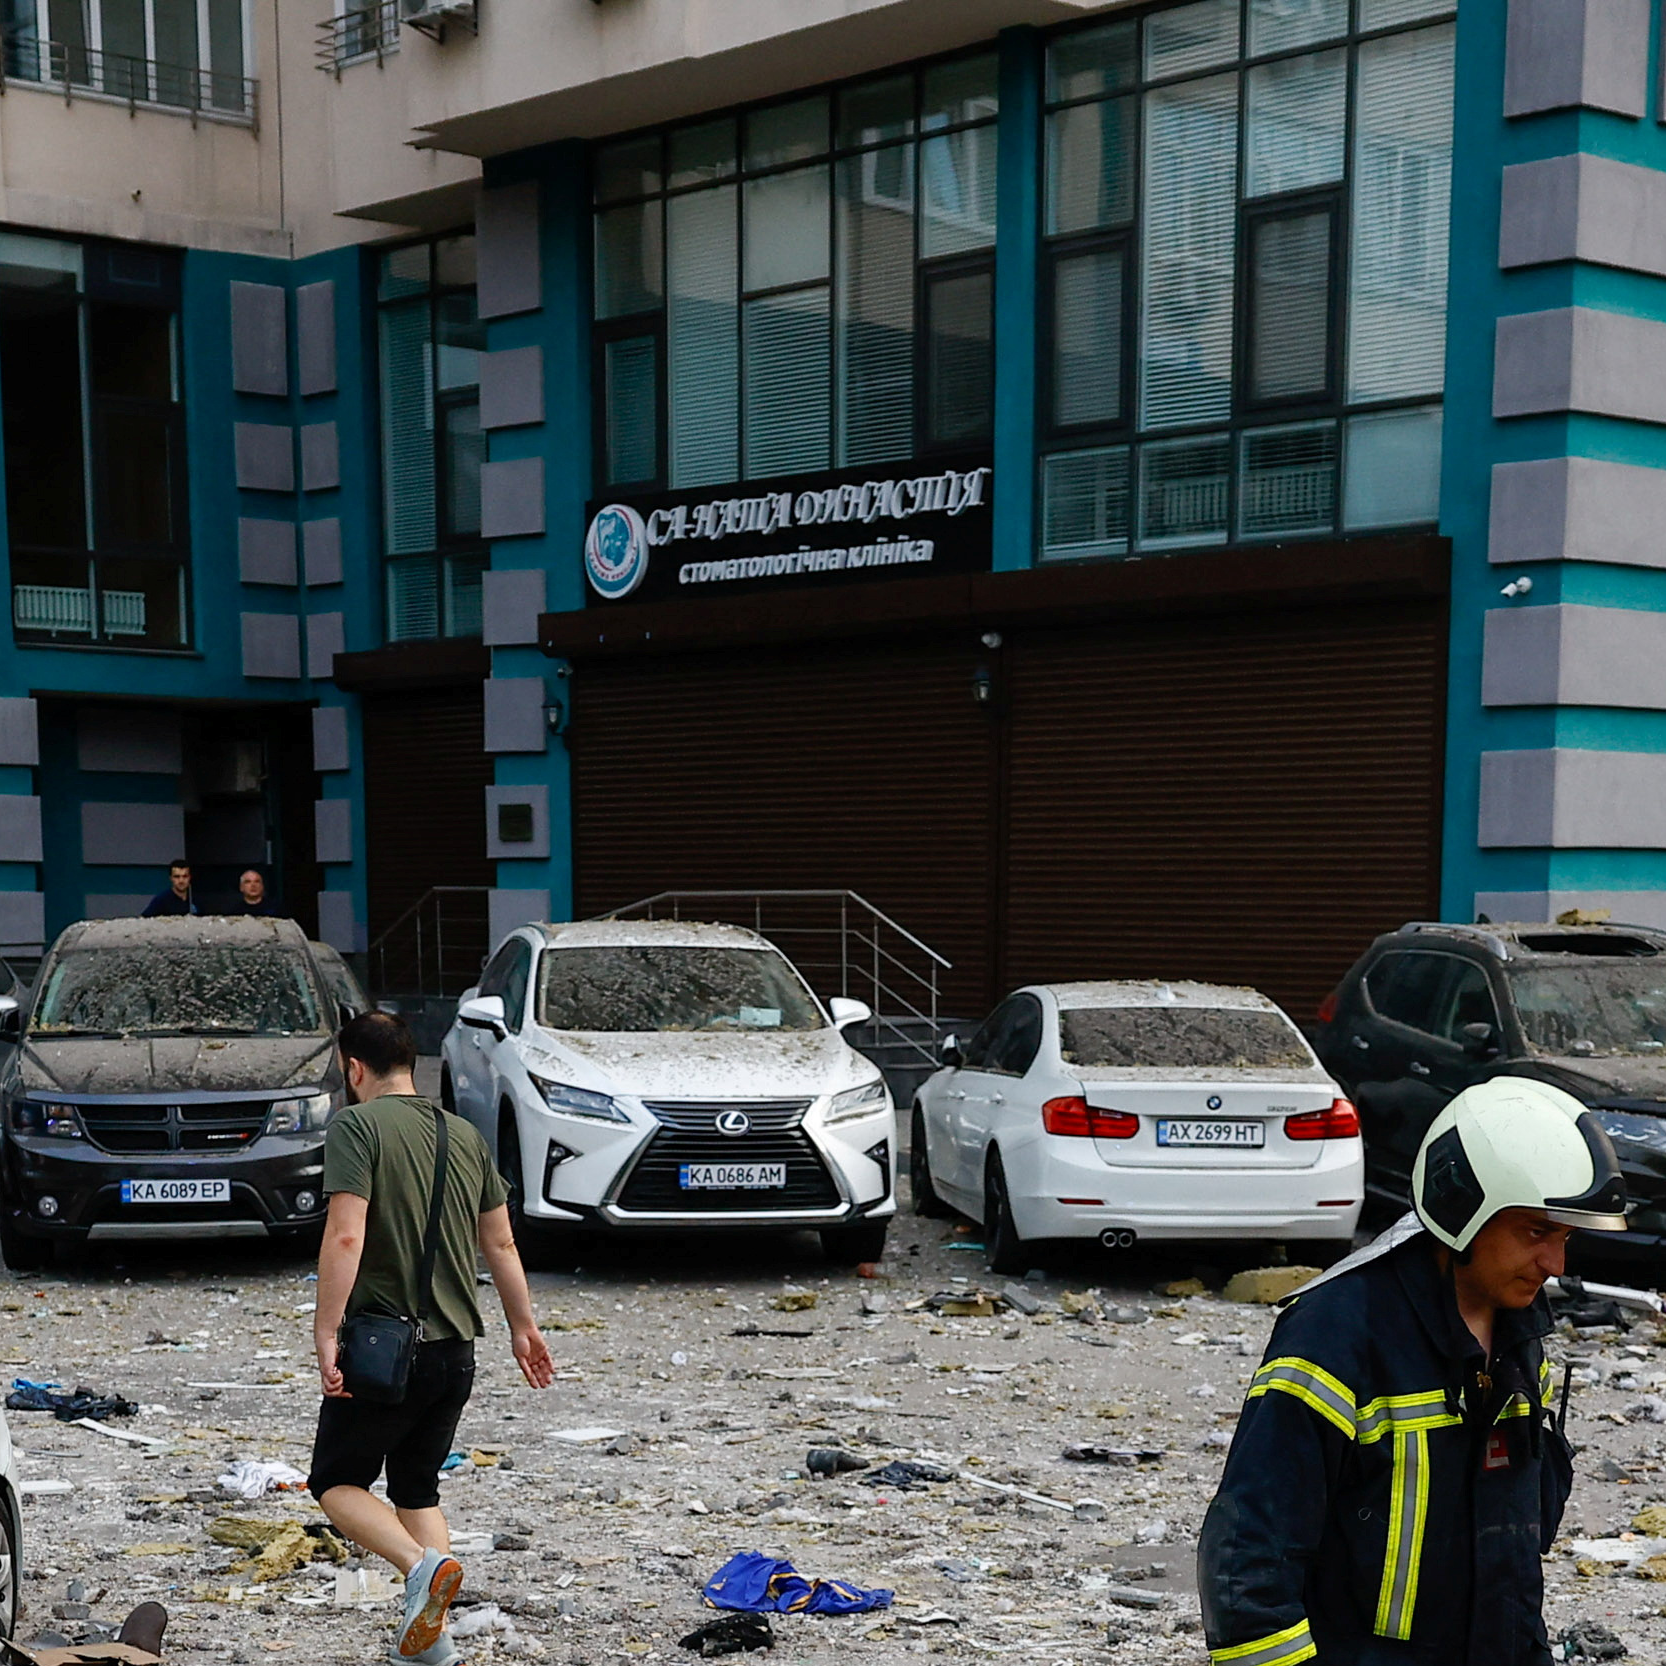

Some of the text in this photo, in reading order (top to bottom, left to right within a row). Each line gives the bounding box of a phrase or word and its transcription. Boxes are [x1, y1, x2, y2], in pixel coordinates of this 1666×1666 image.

[678, 545, 847, 585] стоматологічна
[847, 535, 934, 568] клініка
[1168, 1123, 1258, 1142] AX 2699 HT
[690, 1166, 782, 1183] KA 0686 AM
[132, 1182, 225, 1199] KA 6089 EP
